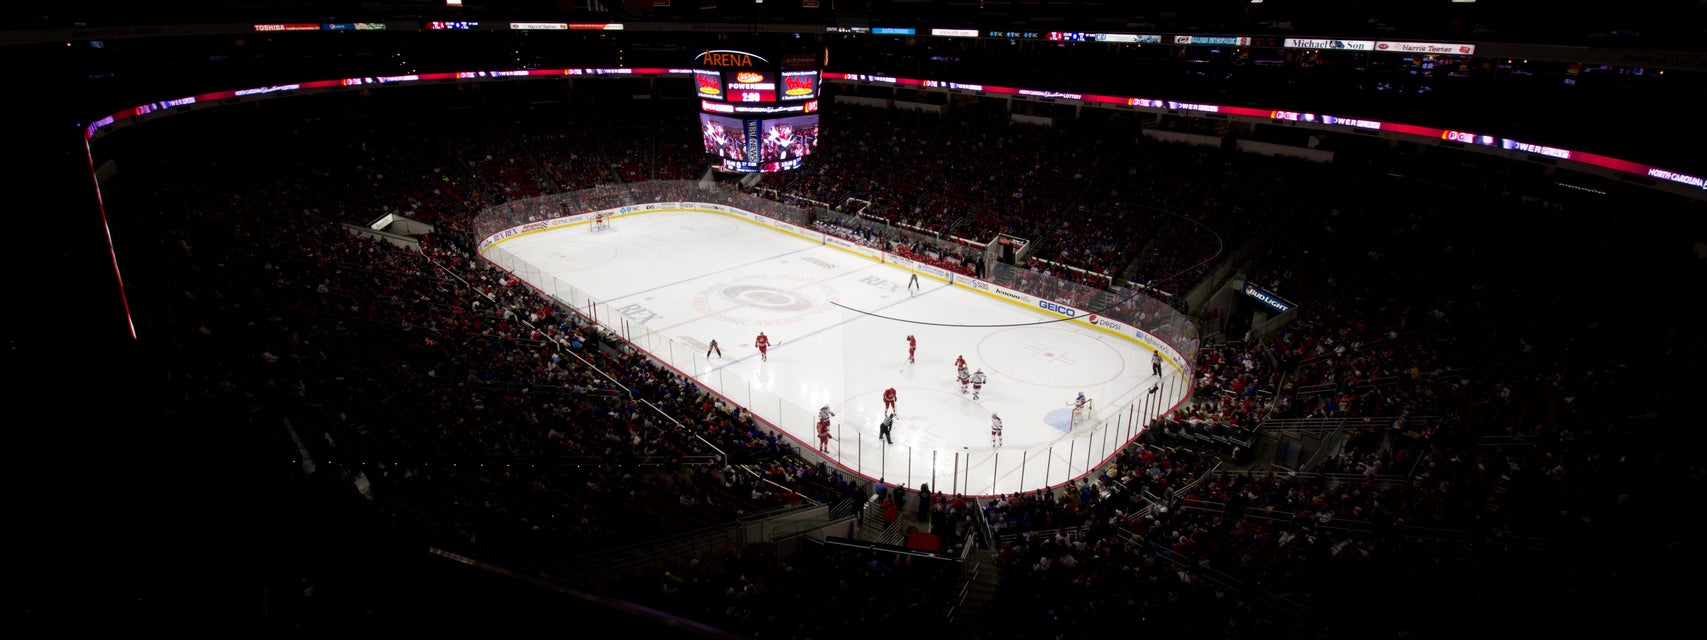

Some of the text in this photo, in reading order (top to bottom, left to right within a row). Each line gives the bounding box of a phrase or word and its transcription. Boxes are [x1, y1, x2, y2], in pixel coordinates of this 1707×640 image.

[1293, 39, 1365, 50] Michael Son
[1428, 45, 1453, 53] Teeter
[703, 50, 753, 67] ARENA
[1648, 168, 1672, 180] NORTH
[1671, 173, 1703, 187] CAROLINA
[995, 288, 1021, 300] lenovo
[1249, 288, 1289, 312] BUD LIGHT
[615, 303, 659, 325] REX
[1039, 299, 1076, 317] GEICO
[1099, 319, 1121, 331] pepsi
